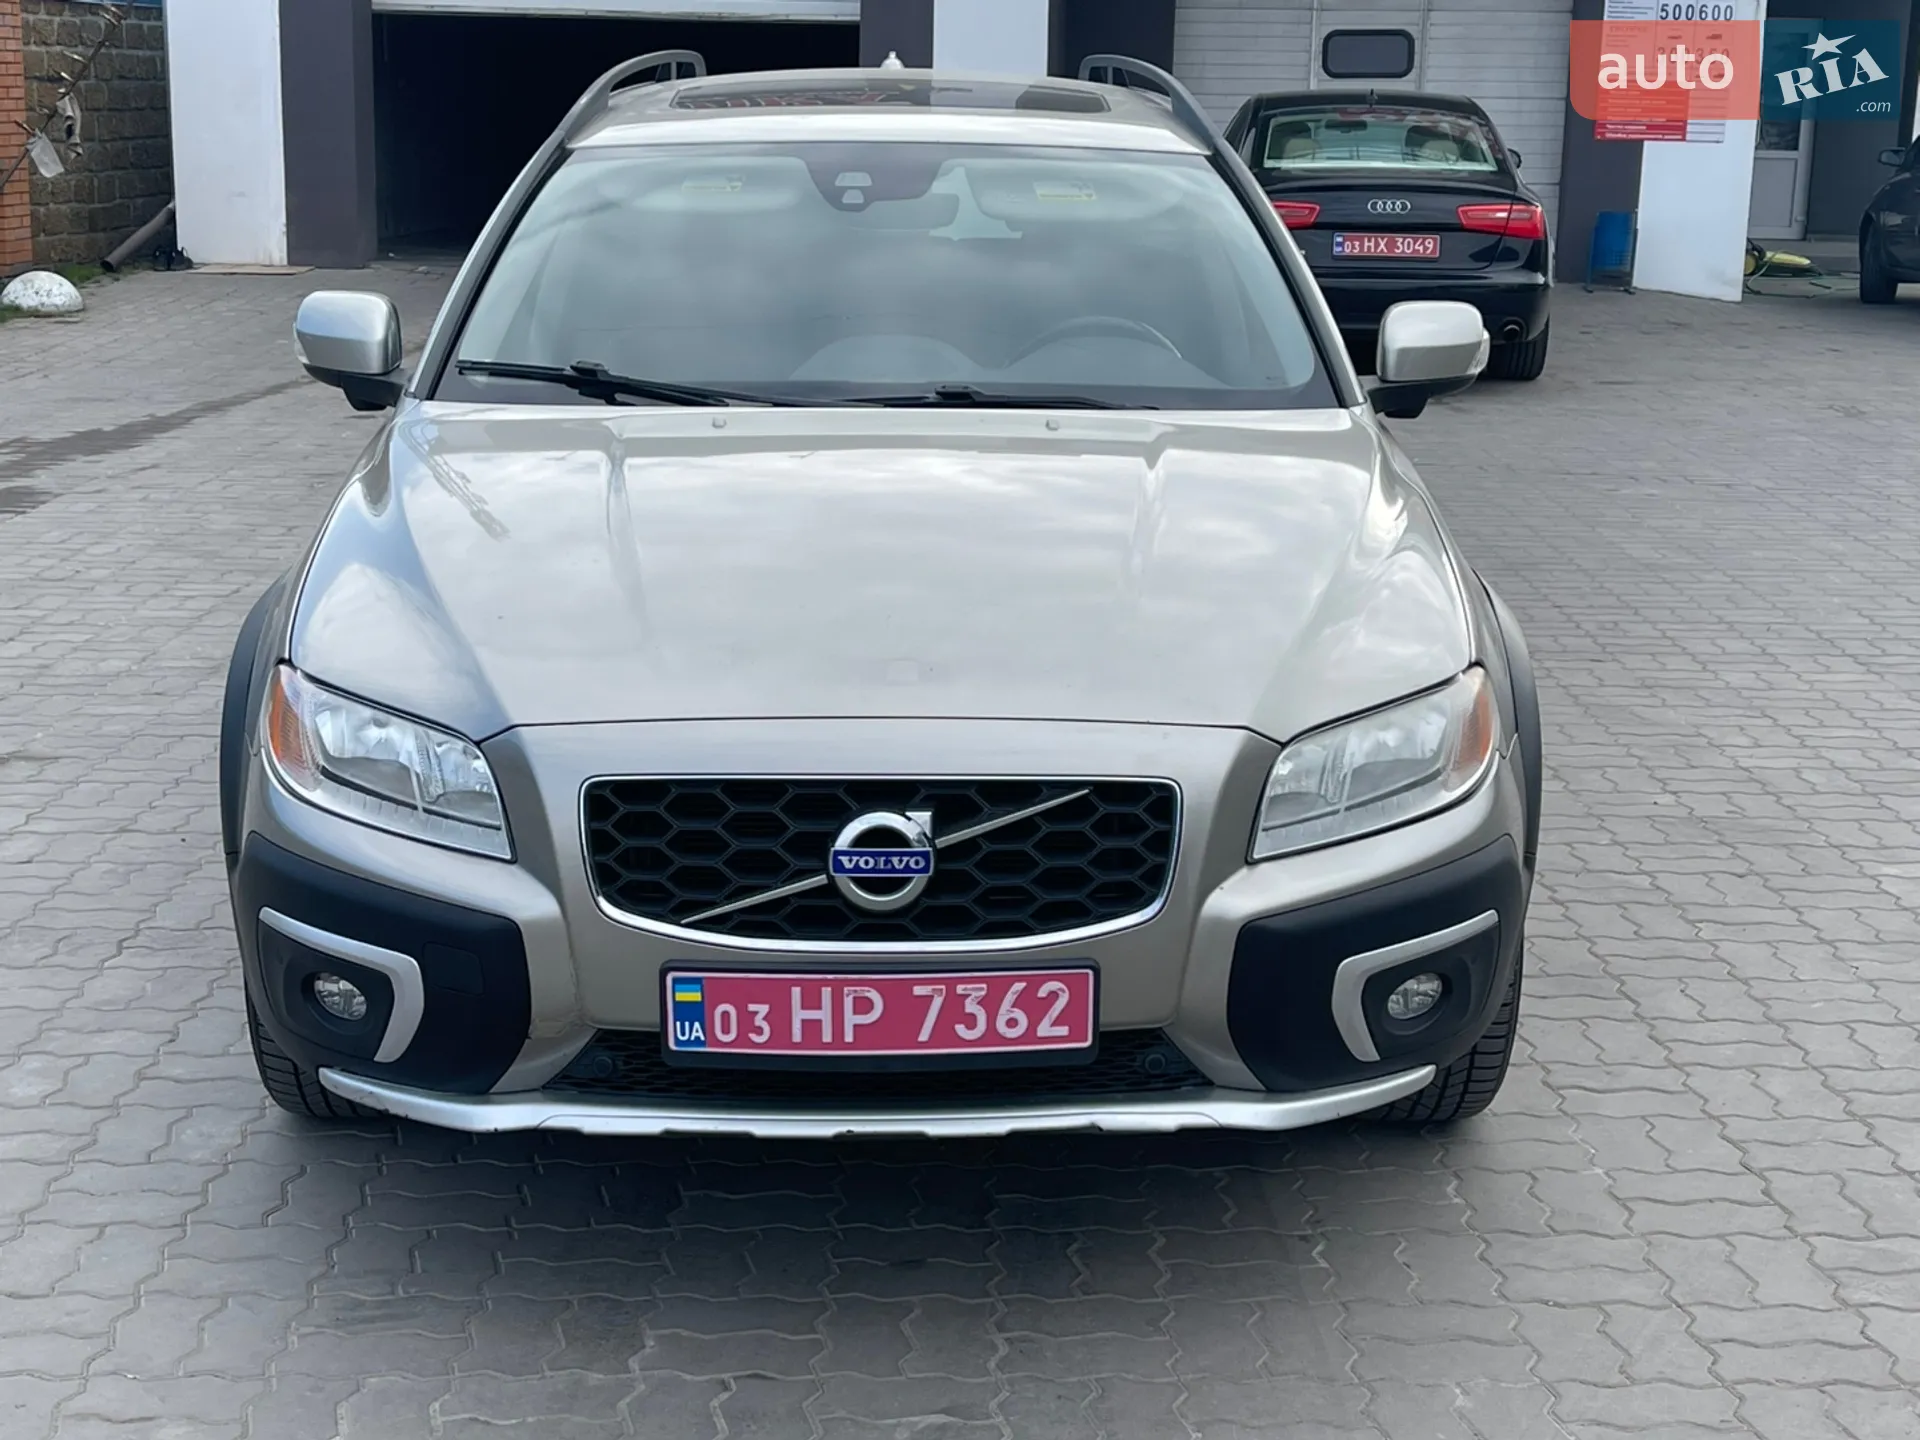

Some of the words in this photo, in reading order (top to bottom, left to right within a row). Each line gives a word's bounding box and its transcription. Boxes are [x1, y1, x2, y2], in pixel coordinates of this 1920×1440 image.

[1659, 3, 1695, 21] 500
[1698, 4, 1734, 21] 600
[1344, 241, 1360, 254] 03
[1363, 237, 1389, 254] HX
[1394, 237, 1435, 255] 3049
[838, 855, 926, 870] VOLVO
[713, 1003, 771, 1044] 03
[790, 986, 885, 1043] HP
[912, 981, 1070, 1043] 7362
[675, 1021, 706, 1042] UA
